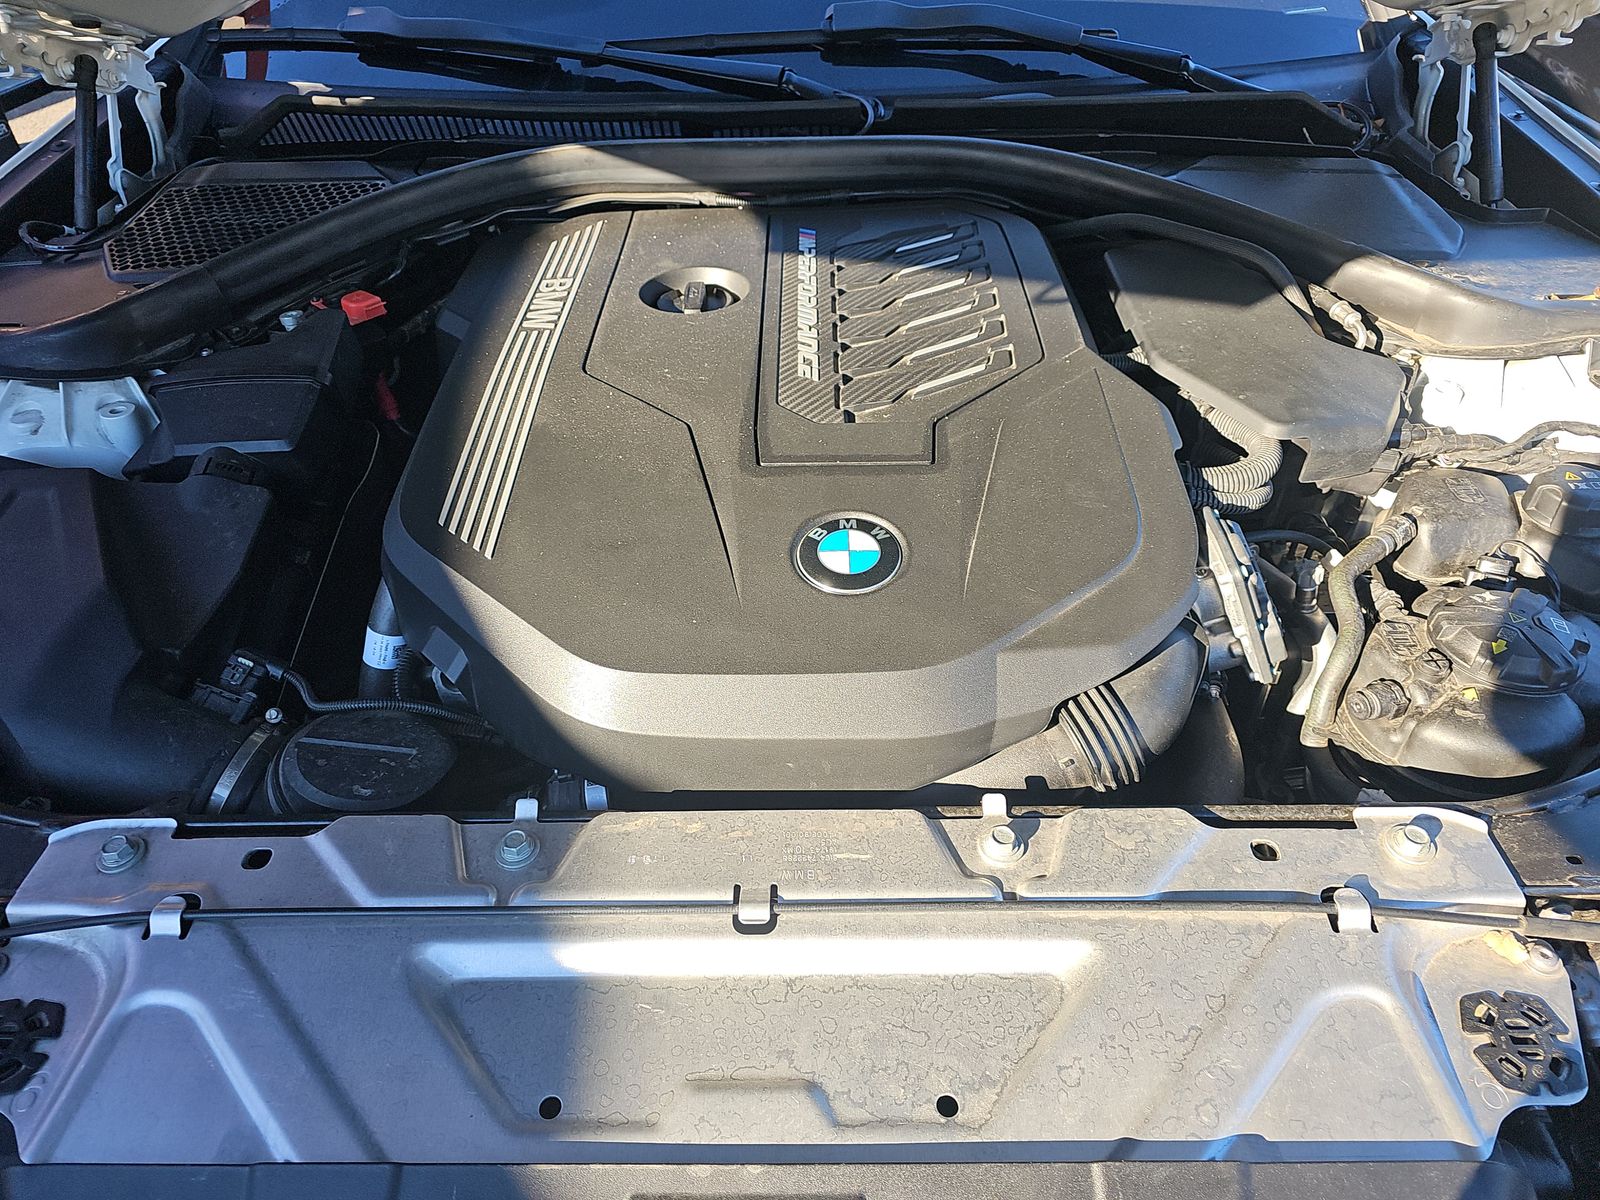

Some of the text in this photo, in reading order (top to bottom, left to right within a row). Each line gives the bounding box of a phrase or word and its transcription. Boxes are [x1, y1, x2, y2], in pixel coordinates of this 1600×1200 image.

[522, 275, 573, 329] BMW
[797, 248, 820, 382] PERFORMANCE
[808, 519, 891, 541] BMW
